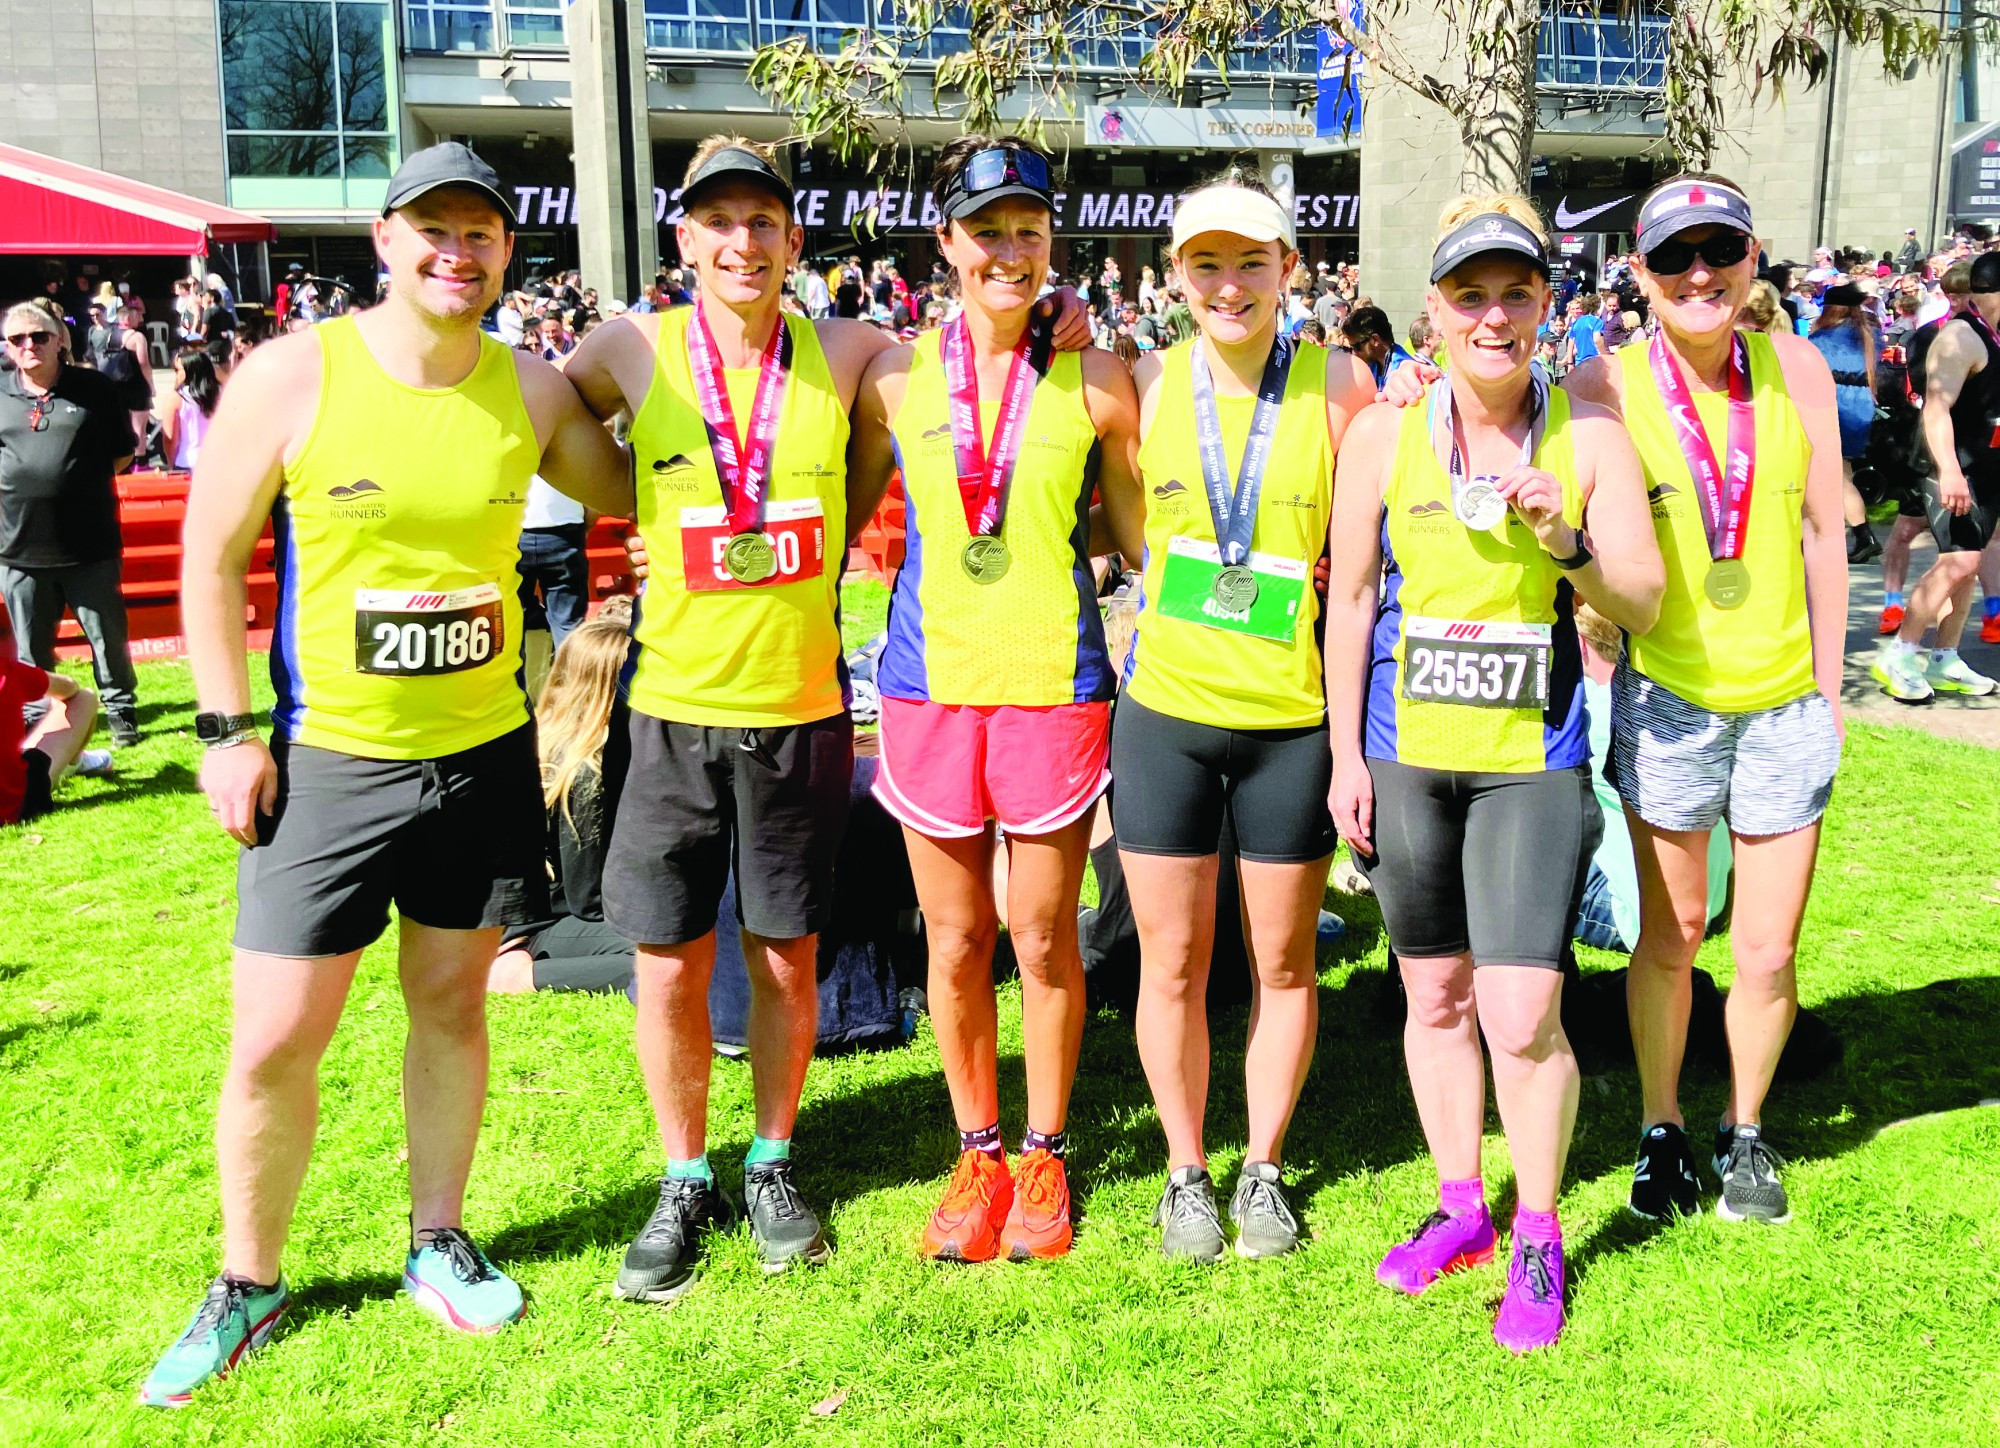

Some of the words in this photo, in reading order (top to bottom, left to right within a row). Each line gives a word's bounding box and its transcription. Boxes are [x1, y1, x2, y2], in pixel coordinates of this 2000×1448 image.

[1208, 122, 1237, 136] THE
[1272, 154, 1293, 162] GATE
[1078, 193, 1184, 227] MARA
[1295, 195, 1360, 227] ESTI
[771, 334, 784, 373] MARATHON
[1018, 346, 1032, 378] FINISHER
[1659, 356, 1678, 391] FINISHER
[761, 374, 777, 420] MELBOURNE
[1008, 379, 1024, 420] MARATHON
[756, 421, 767, 439] NIKE
[996, 421, 1014, 468] MELBOURNE
[991, 468, 1002, 487] NIKE
[1699, 460, 1712, 479] NIKE
[330, 509, 387, 519] RUNNERS
[1214, 483, 1229, 520] FINISHER
[1239, 479, 1253, 516] FINISHER
[1652, 509, 1685, 519] NNERS
[1728, 511, 1739, 528] NIKE
[373, 616, 490, 669] 20186
[1411, 647, 1527, 700] 25537
